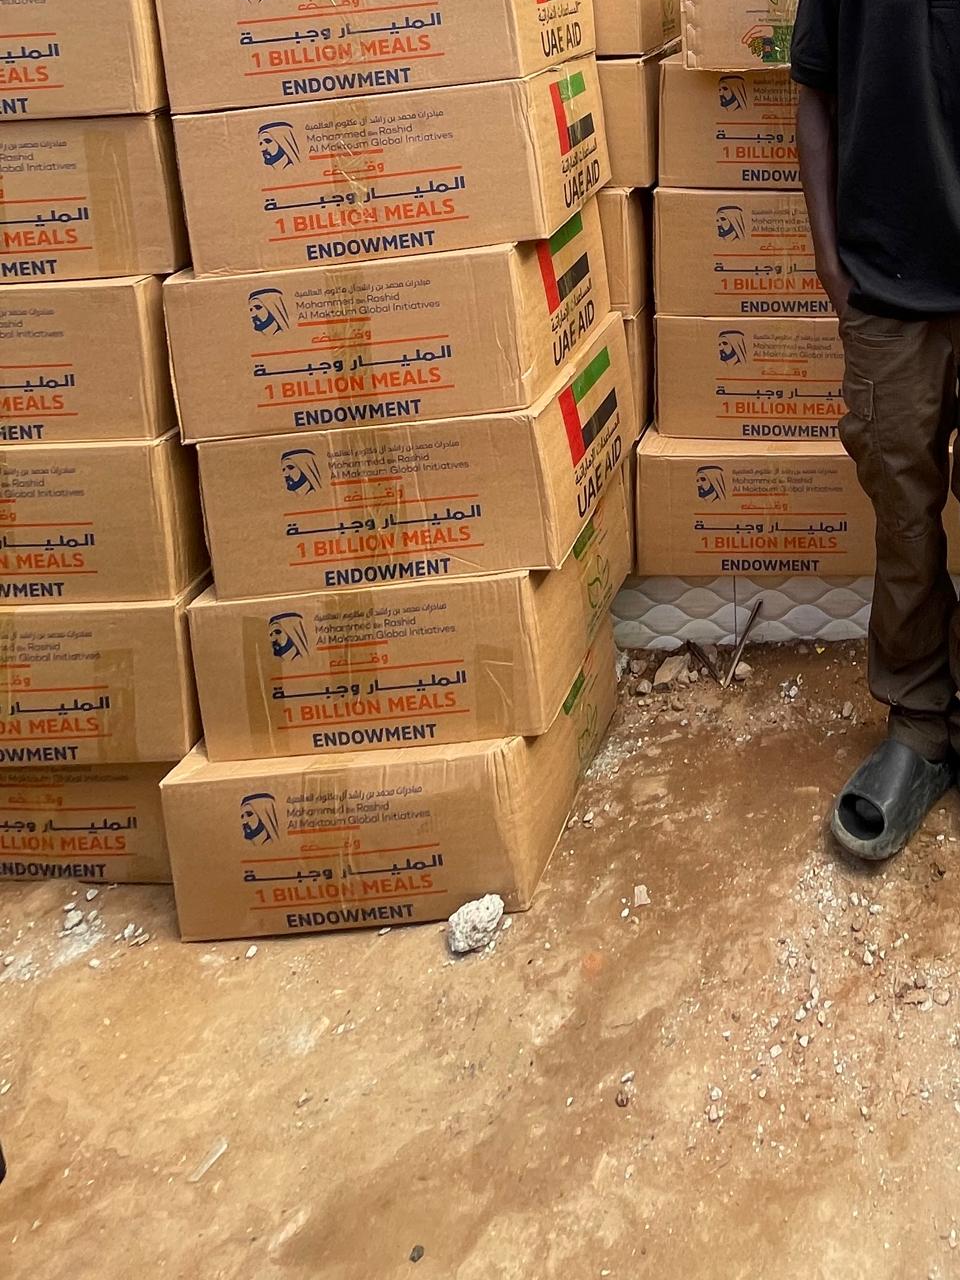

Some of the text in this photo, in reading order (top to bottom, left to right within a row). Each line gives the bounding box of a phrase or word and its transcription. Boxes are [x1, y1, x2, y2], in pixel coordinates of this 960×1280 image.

[251, 34, 431, 68] 1 BILLION MEALS
[540, 21, 582, 58] UAE AID
[280, 66, 412, 96] ENDOWMENT
[306, 128, 366, 143] Mohammed
[379, 123, 412, 135] Rashid
[320, 139, 369, 153] Maktoum
[370, 135, 404, 147] Global
[404, 129, 453, 144] Initiatives
[563, 158, 600, 209] UAE AID
[275, 197, 455, 234] 1 BILLION MEALS
[4, 228, 78, 246] MEALS
[305, 229, 436, 260] ENDOWMENT
[721, 277, 795, 290] 1 BILLION
[553, 299, 595, 366] UAE AID
[264, 366, 441, 400] 1 BILLION MEALS
[293, 398, 422, 427] ENDOWMENT
[803, 402, 846, 415] MEAL
[742, 423, 838, 437] ENDOWMENT
[577, 434, 622, 518] UAE AID
[295, 525, 471, 559] 1 BILLION MEALS
[702, 536, 837, 549] 1 BILLION MEALS
[15, 552, 84, 568] MEALS
[324, 556, 452, 586] ENDOWMENT
[721, 558, 819, 571] ENDOWMENT
[284, 691, 456, 722] 1 BILLION MEALS
[29, 716, 98, 732] MEALS
[312, 722, 437, 748] ENDOWMENT
[61, 835, 125, 849] MEALS
[256, 874, 432, 903] 1 BILLION MEALS
[286, 903, 414, 928] ENDOWMENT
